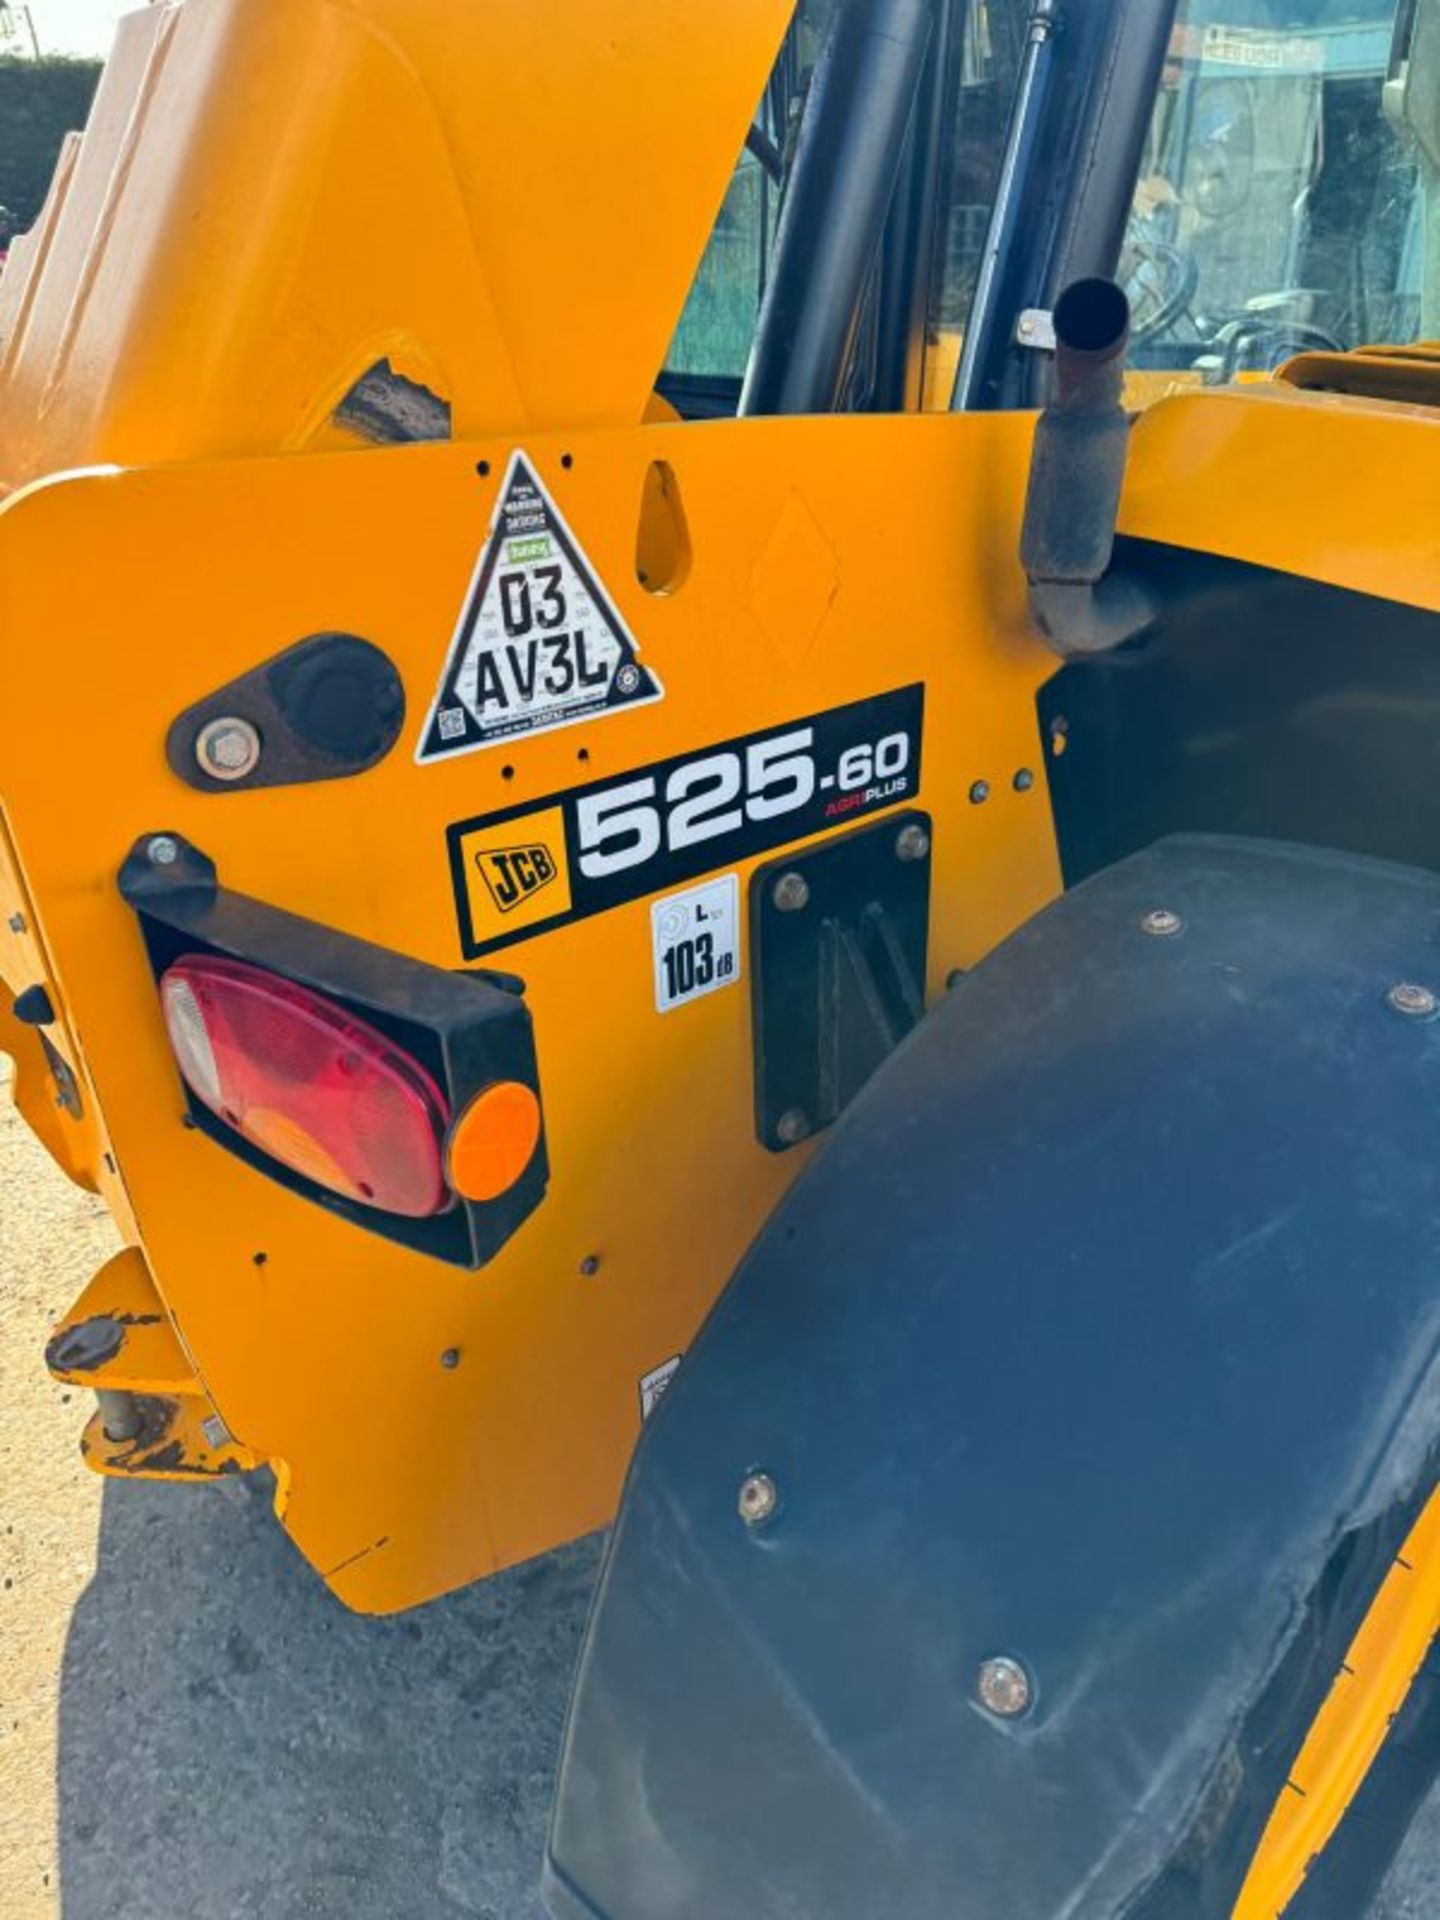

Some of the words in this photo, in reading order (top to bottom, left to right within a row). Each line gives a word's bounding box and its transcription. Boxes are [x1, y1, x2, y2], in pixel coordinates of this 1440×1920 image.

[475, 630, 608, 715] AV3L
[576, 726, 909, 878] 525-60
[825, 776, 908, 817] AGRIPLUS
[487, 849, 552, 904] JCB
[663, 931, 713, 999] 103
